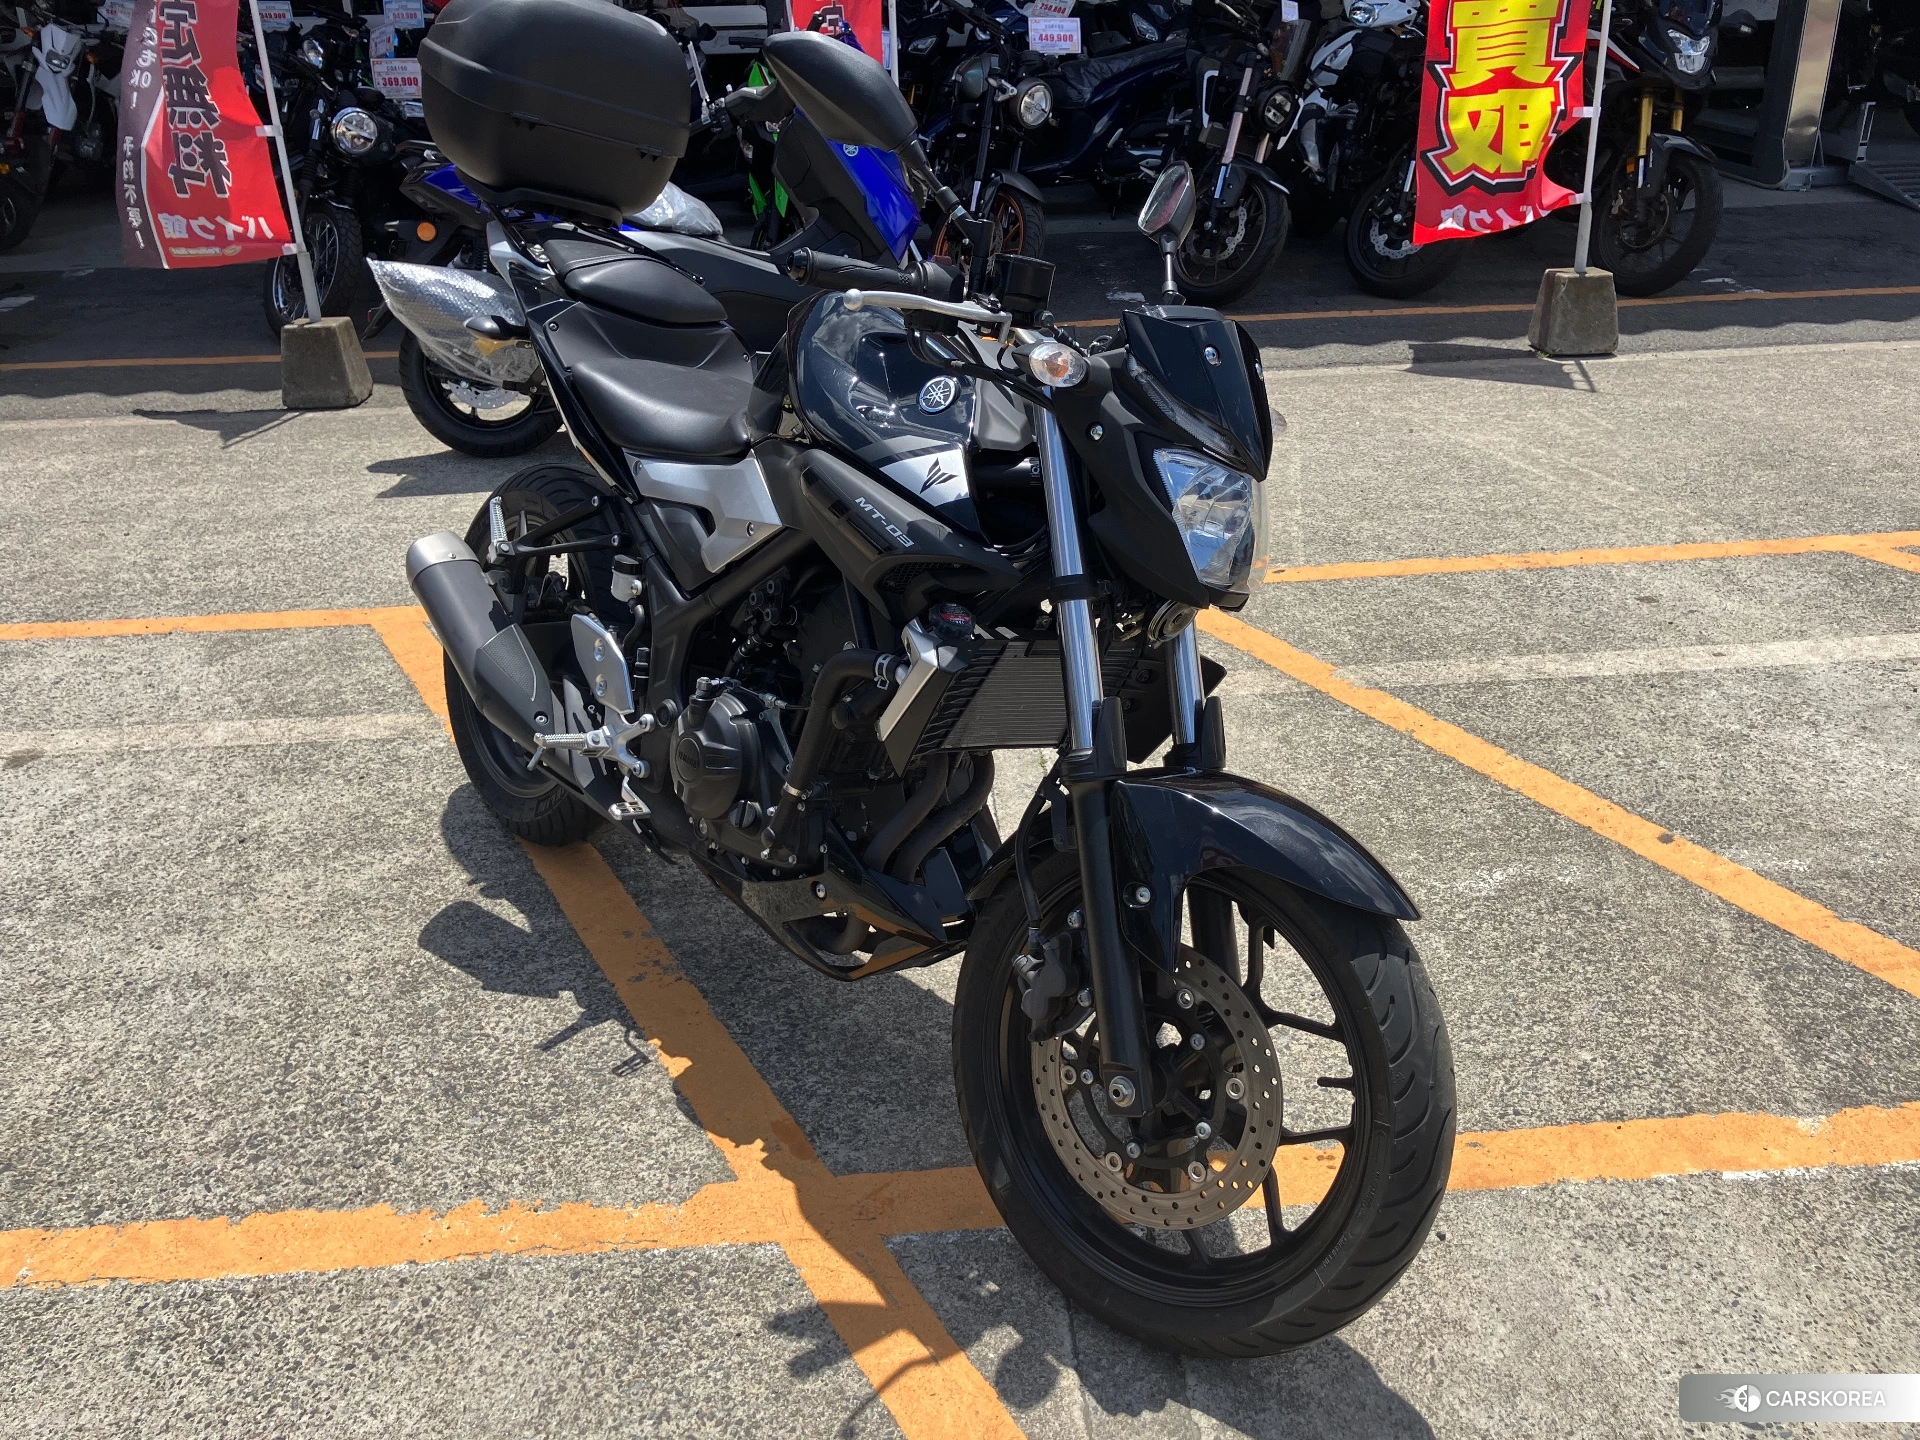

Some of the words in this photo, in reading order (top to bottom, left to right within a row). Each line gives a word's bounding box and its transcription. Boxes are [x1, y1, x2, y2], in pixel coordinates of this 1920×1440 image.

[1038, 33, 1074, 43] 449,900
[381, 76, 419, 87] 369,900
[854, 496, 915, 548] MT-03
